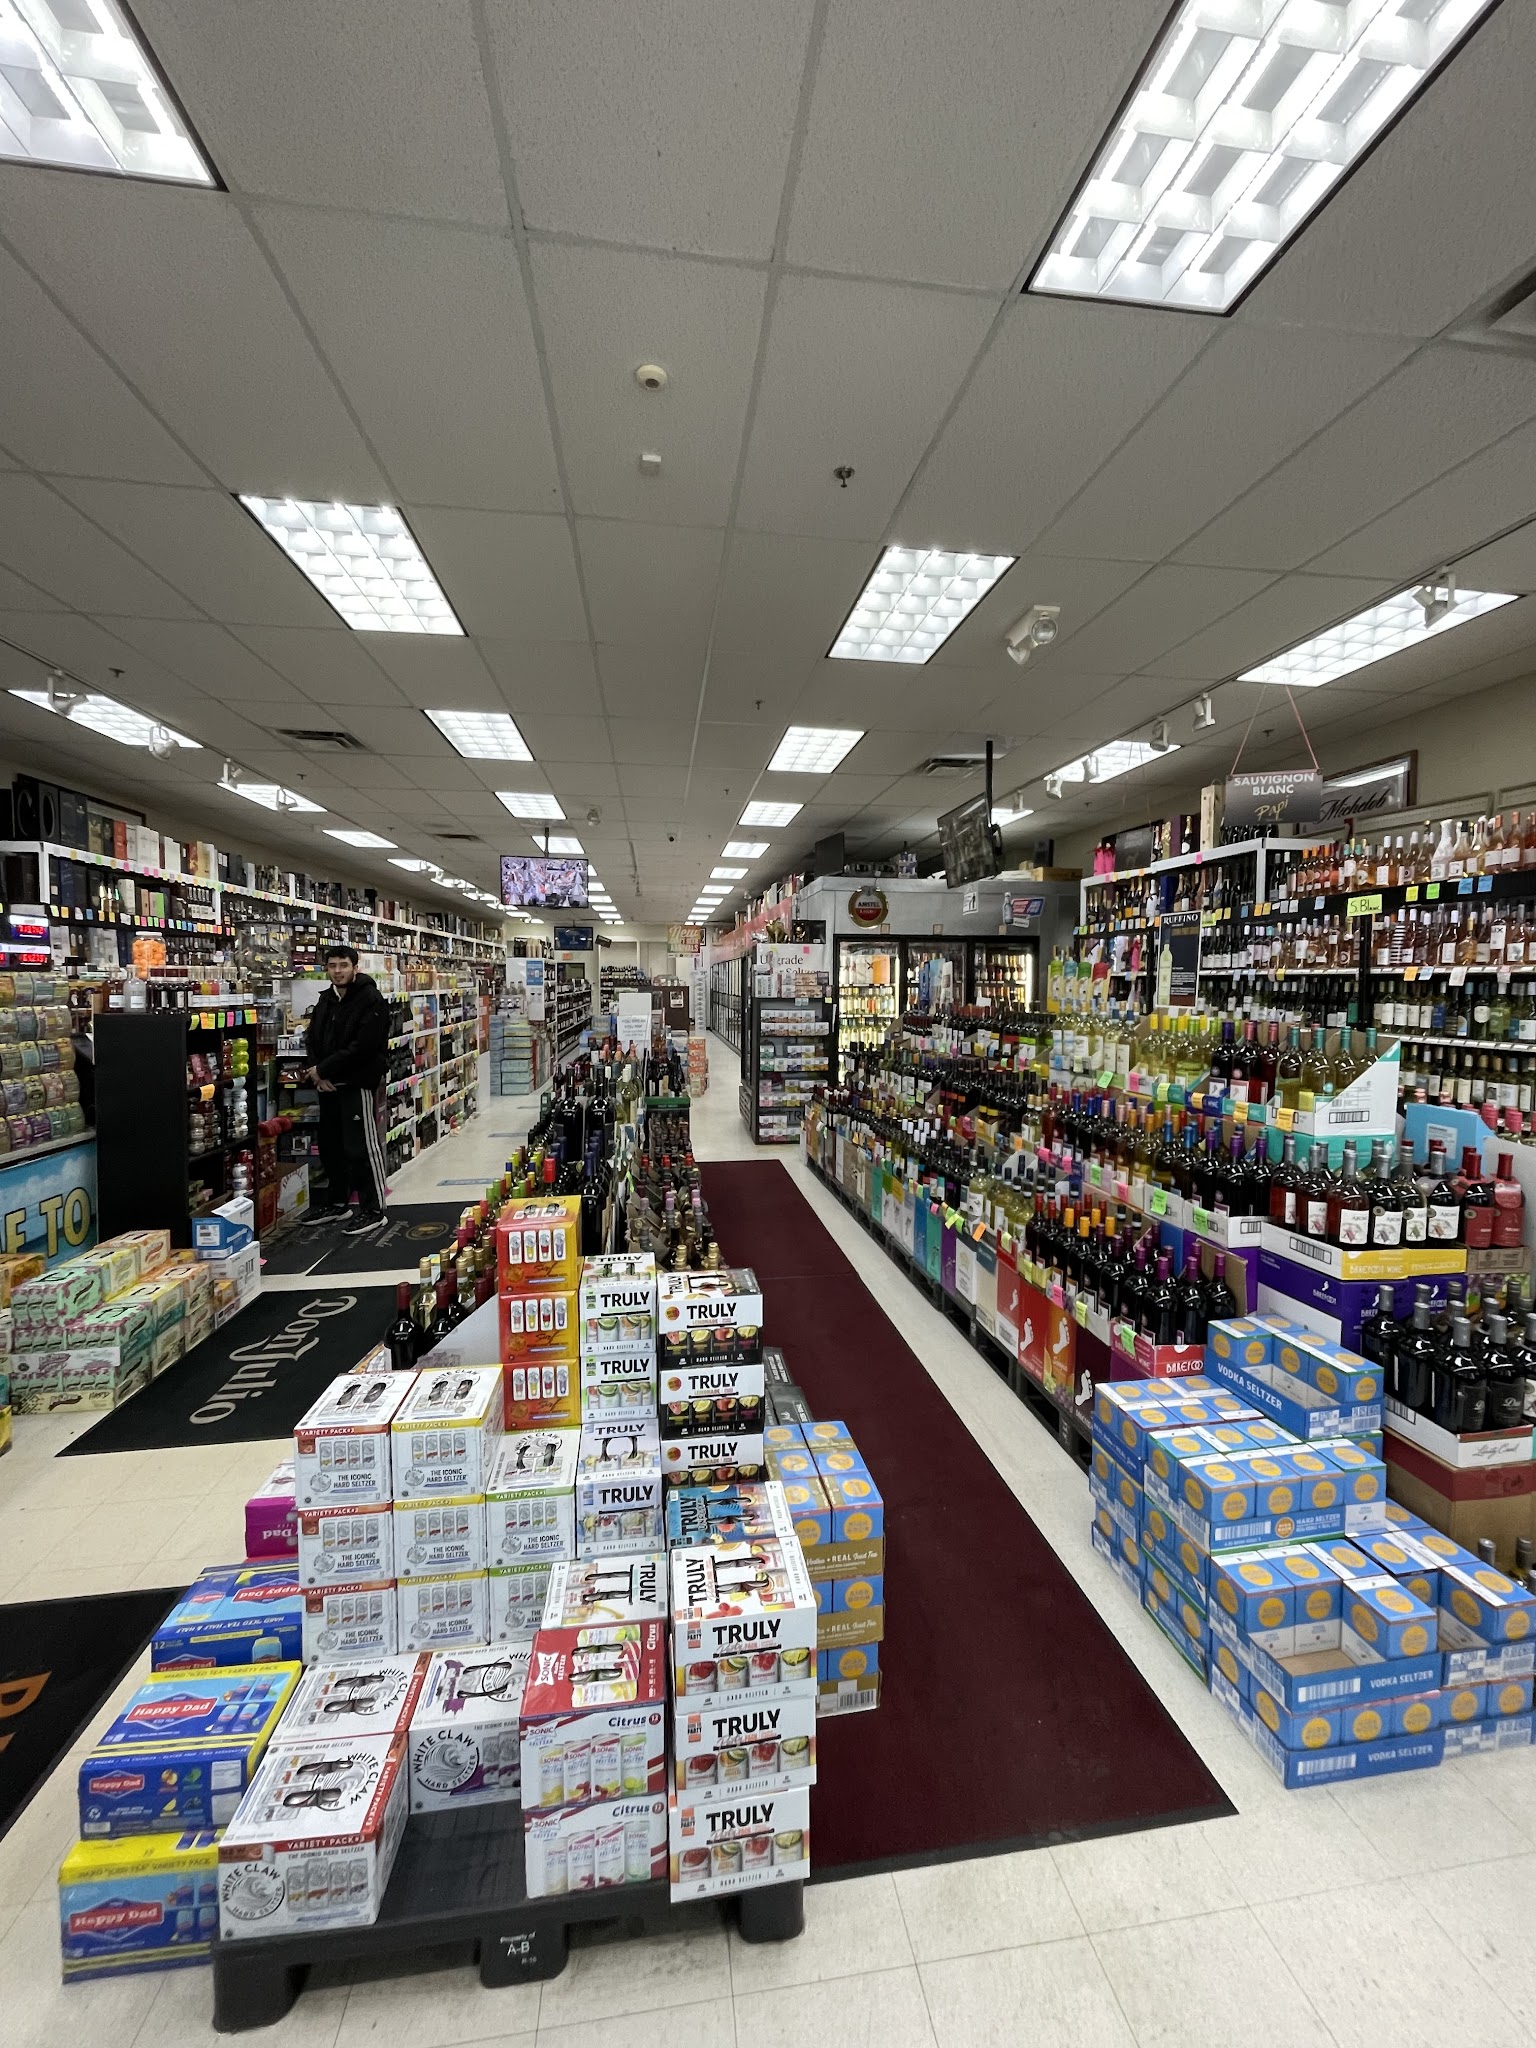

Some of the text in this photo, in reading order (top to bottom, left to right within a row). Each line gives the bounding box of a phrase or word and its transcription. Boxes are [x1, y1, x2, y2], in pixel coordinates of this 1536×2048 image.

[1234, 772, 1314, 786] SAUVIGNON
[1252, 784, 1294, 796] BLANC
[1254, 796, 1289, 821] Papi
[1317, 788, 1390, 824] Michelob
[1164, 914, 1198, 924] RUFFINO
[760, 954, 803, 968] Ugrade
[39, 1186, 91, 1258] TO
[670, 1274, 683, 1294] TRULY
[600, 1291, 650, 1308] TRULY
[686, 1302, 737, 1319] TRULY
[190, 1296, 358, 1424] Don Julio
[600, 1358, 650, 1375] TRULY
[1166, 1360, 1203, 1374] BAREFOO
[688, 1373, 739, 1390] TRULY
[1218, 1362, 1283, 1410] VODKA SELTZER
[535, 1432, 560, 1440] CLAW
[595, 1424, 645, 1435] TRULY
[688, 1442, 738, 1459] TRULY
[598, 1485, 653, 1505] TRULY
[680, 1497, 697, 1535] TRULY
[262, 1529, 292, 1540] Dad
[354, 1552, 376, 1560] ICONIC
[640, 1562, 656, 1603] TRULY
[686, 1558, 707, 1606] TRULY
[239, 1590, 265, 1599] Dad
[437, 1618, 468, 1628] THE ICONIC
[449, 1624, 472, 1632] SELTZER
[832, 1624, 850, 1632] REAL
[647, 1624, 656, 1650] Citrus
[713, 1619, 781, 1645] TRULY
[154, 1642, 165, 1650] 12
[228, 1666, 256, 1674] VARIETY
[541, 1656, 552, 1681] SONIC
[558, 1655, 566, 1680] SELTZER
[1370, 1670, 1434, 1688] VODKA SELTZER
[140, 1686, 154, 1695] 12
[379, 1668, 408, 1710] WHITE CLAW
[134, 1702, 210, 1716] Happy Dad
[608, 1715, 646, 1728] Citrus
[713, 1708, 781, 1737] TRULY
[530, 1727, 554, 1735] SONIC
[414, 1730, 475, 1774] WHITE CLAW
[543, 1756, 562, 1764] SONIC
[1369, 1745, 1433, 1762] VODKA SELTZER
[348, 1753, 378, 1805] WHITE CLAW
[424, 1754, 476, 1789] HARD SELTZER
[93, 1780, 123, 1788] Happy
[612, 1804, 650, 1817] Citrus
[706, 1802, 774, 1832] TRULY
[534, 1819, 558, 1827] SONIC
[681, 1820, 695, 1828] PARTY
[288, 1839, 326, 1849] VARIETY
[341, 1846, 365, 1855] SELTZER
[222, 1864, 280, 1903] WHITE CLAW
[75, 1908, 157, 1928] Happy Dad
[232, 1907, 255, 1917] HARD
[507, 1941, 530, 1956] A-B
